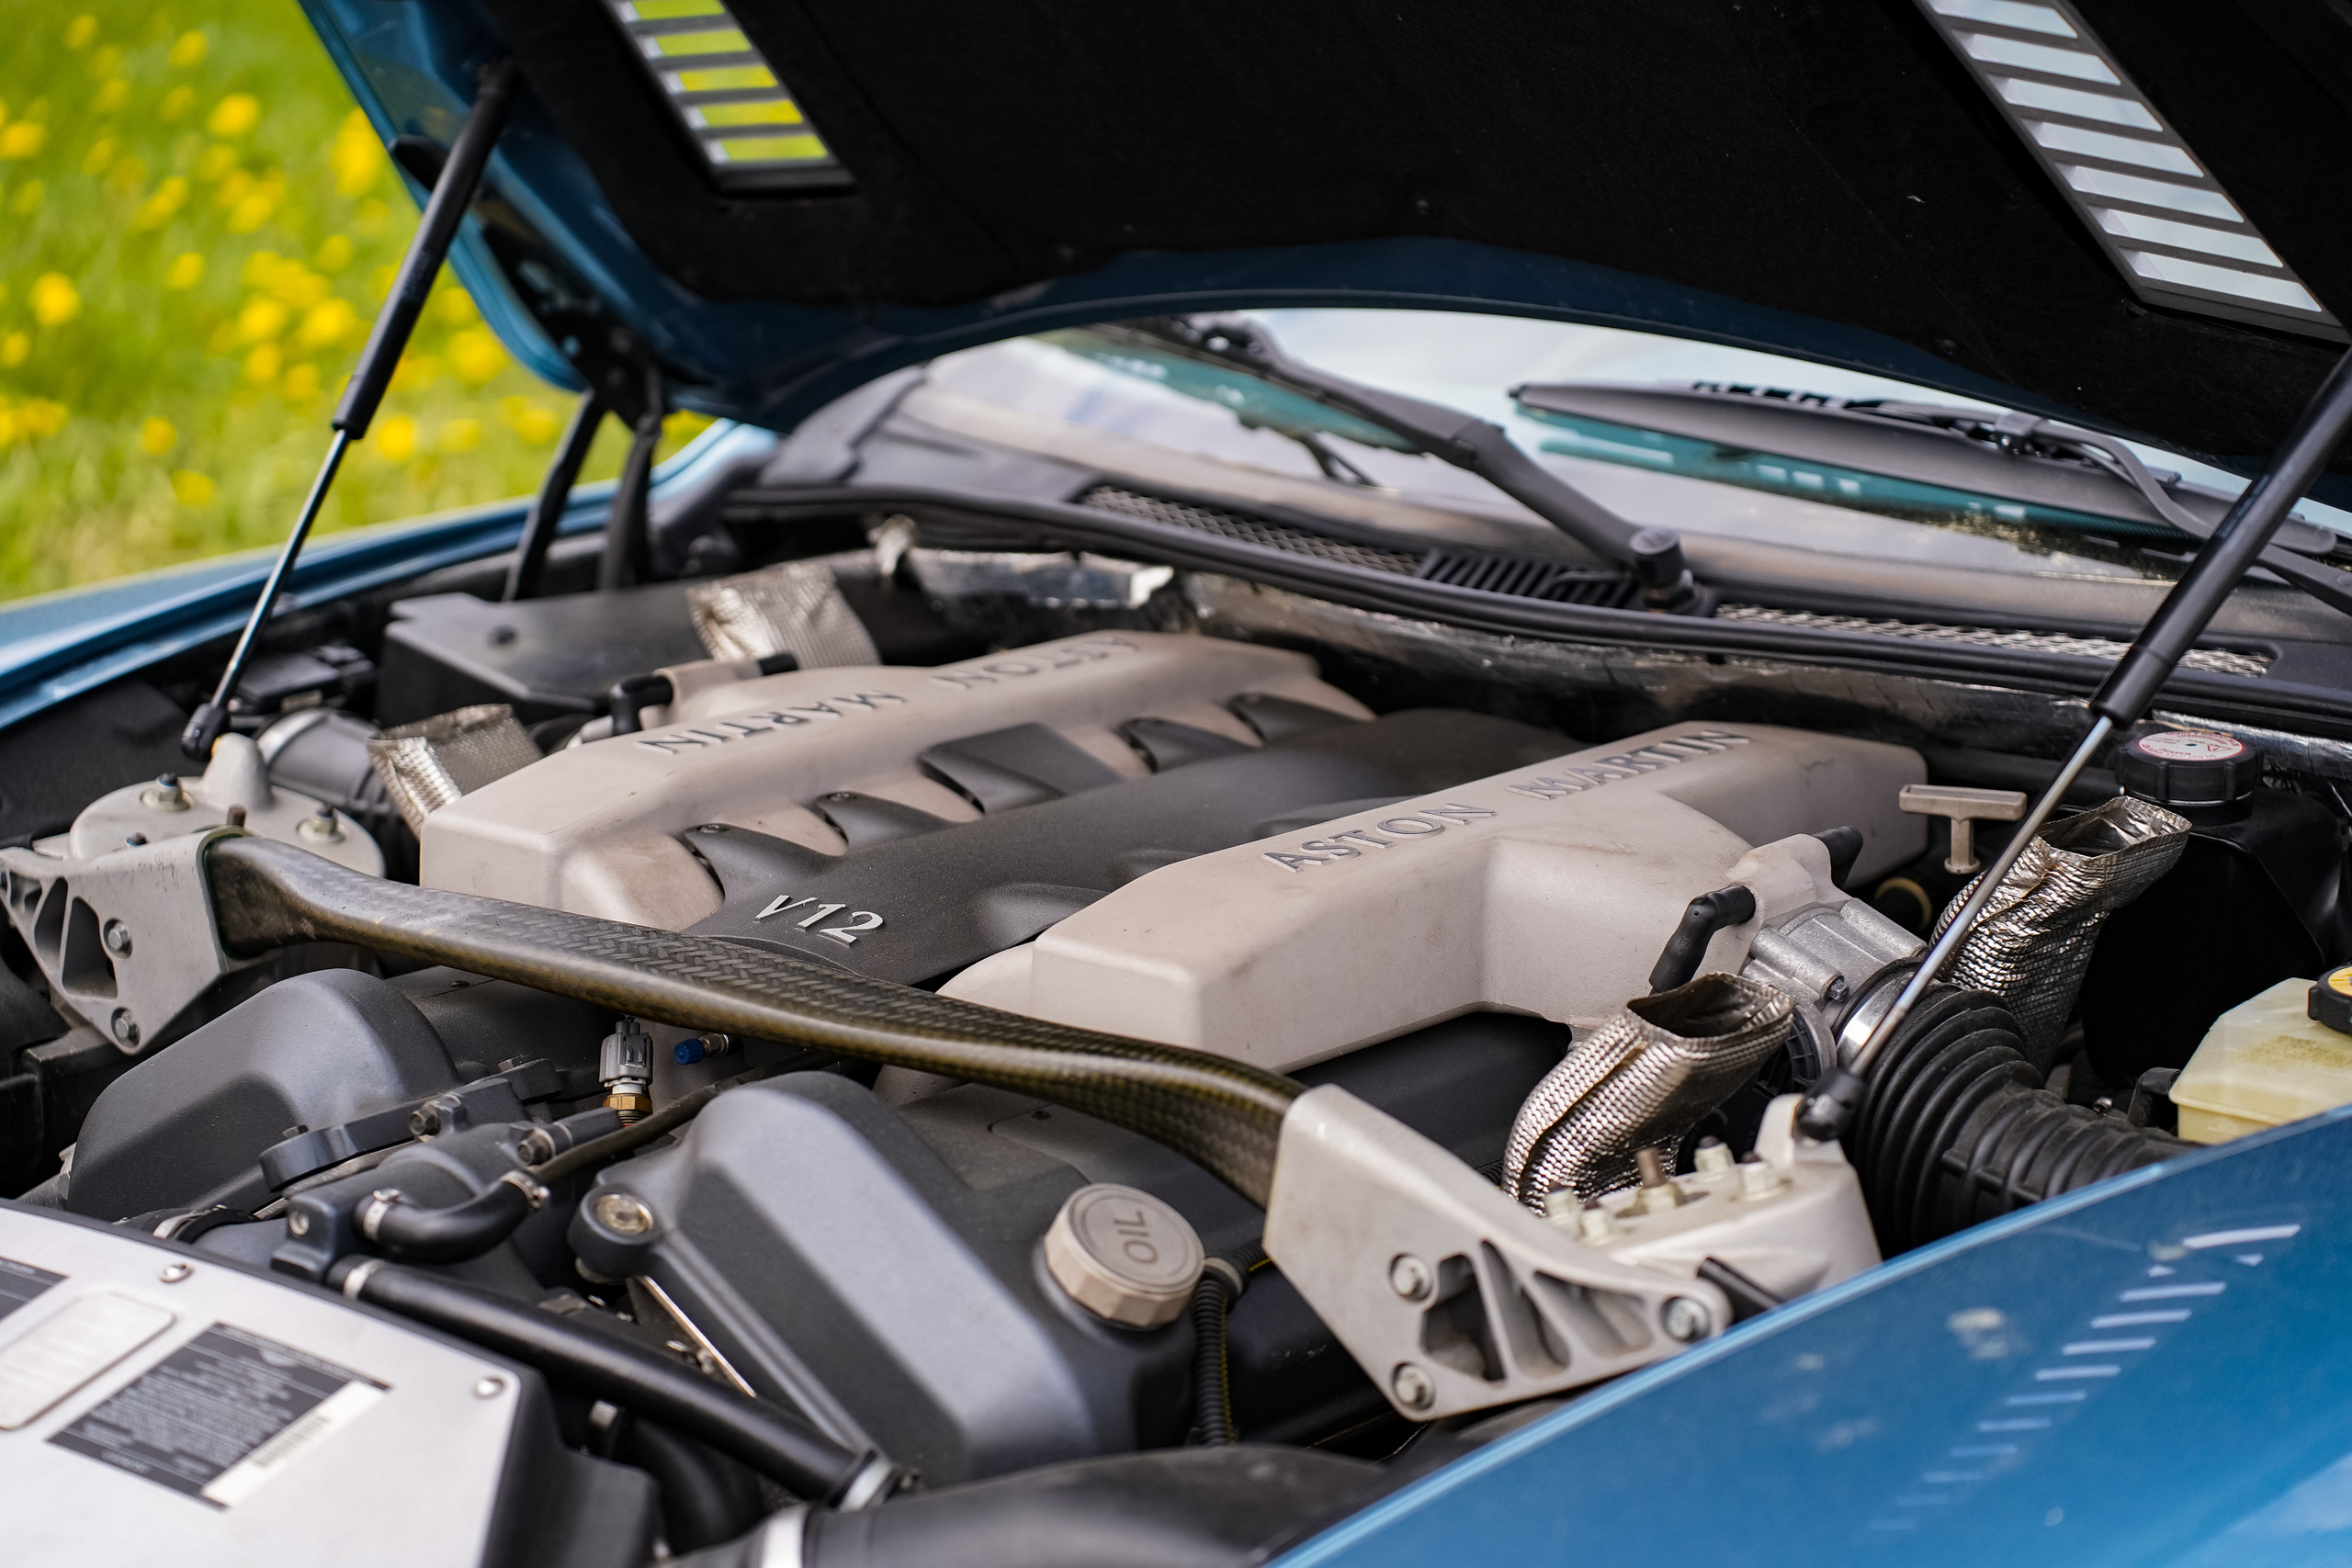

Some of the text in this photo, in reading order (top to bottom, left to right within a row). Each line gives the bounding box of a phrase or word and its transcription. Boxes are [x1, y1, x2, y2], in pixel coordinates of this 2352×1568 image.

[636, 635, 1141, 755] ASTON MARTIN
[1261, 728, 1752, 873] ASTON MARTIN
[752, 894, 884, 948] V12
[1113, 1209, 1159, 1265] OIL
